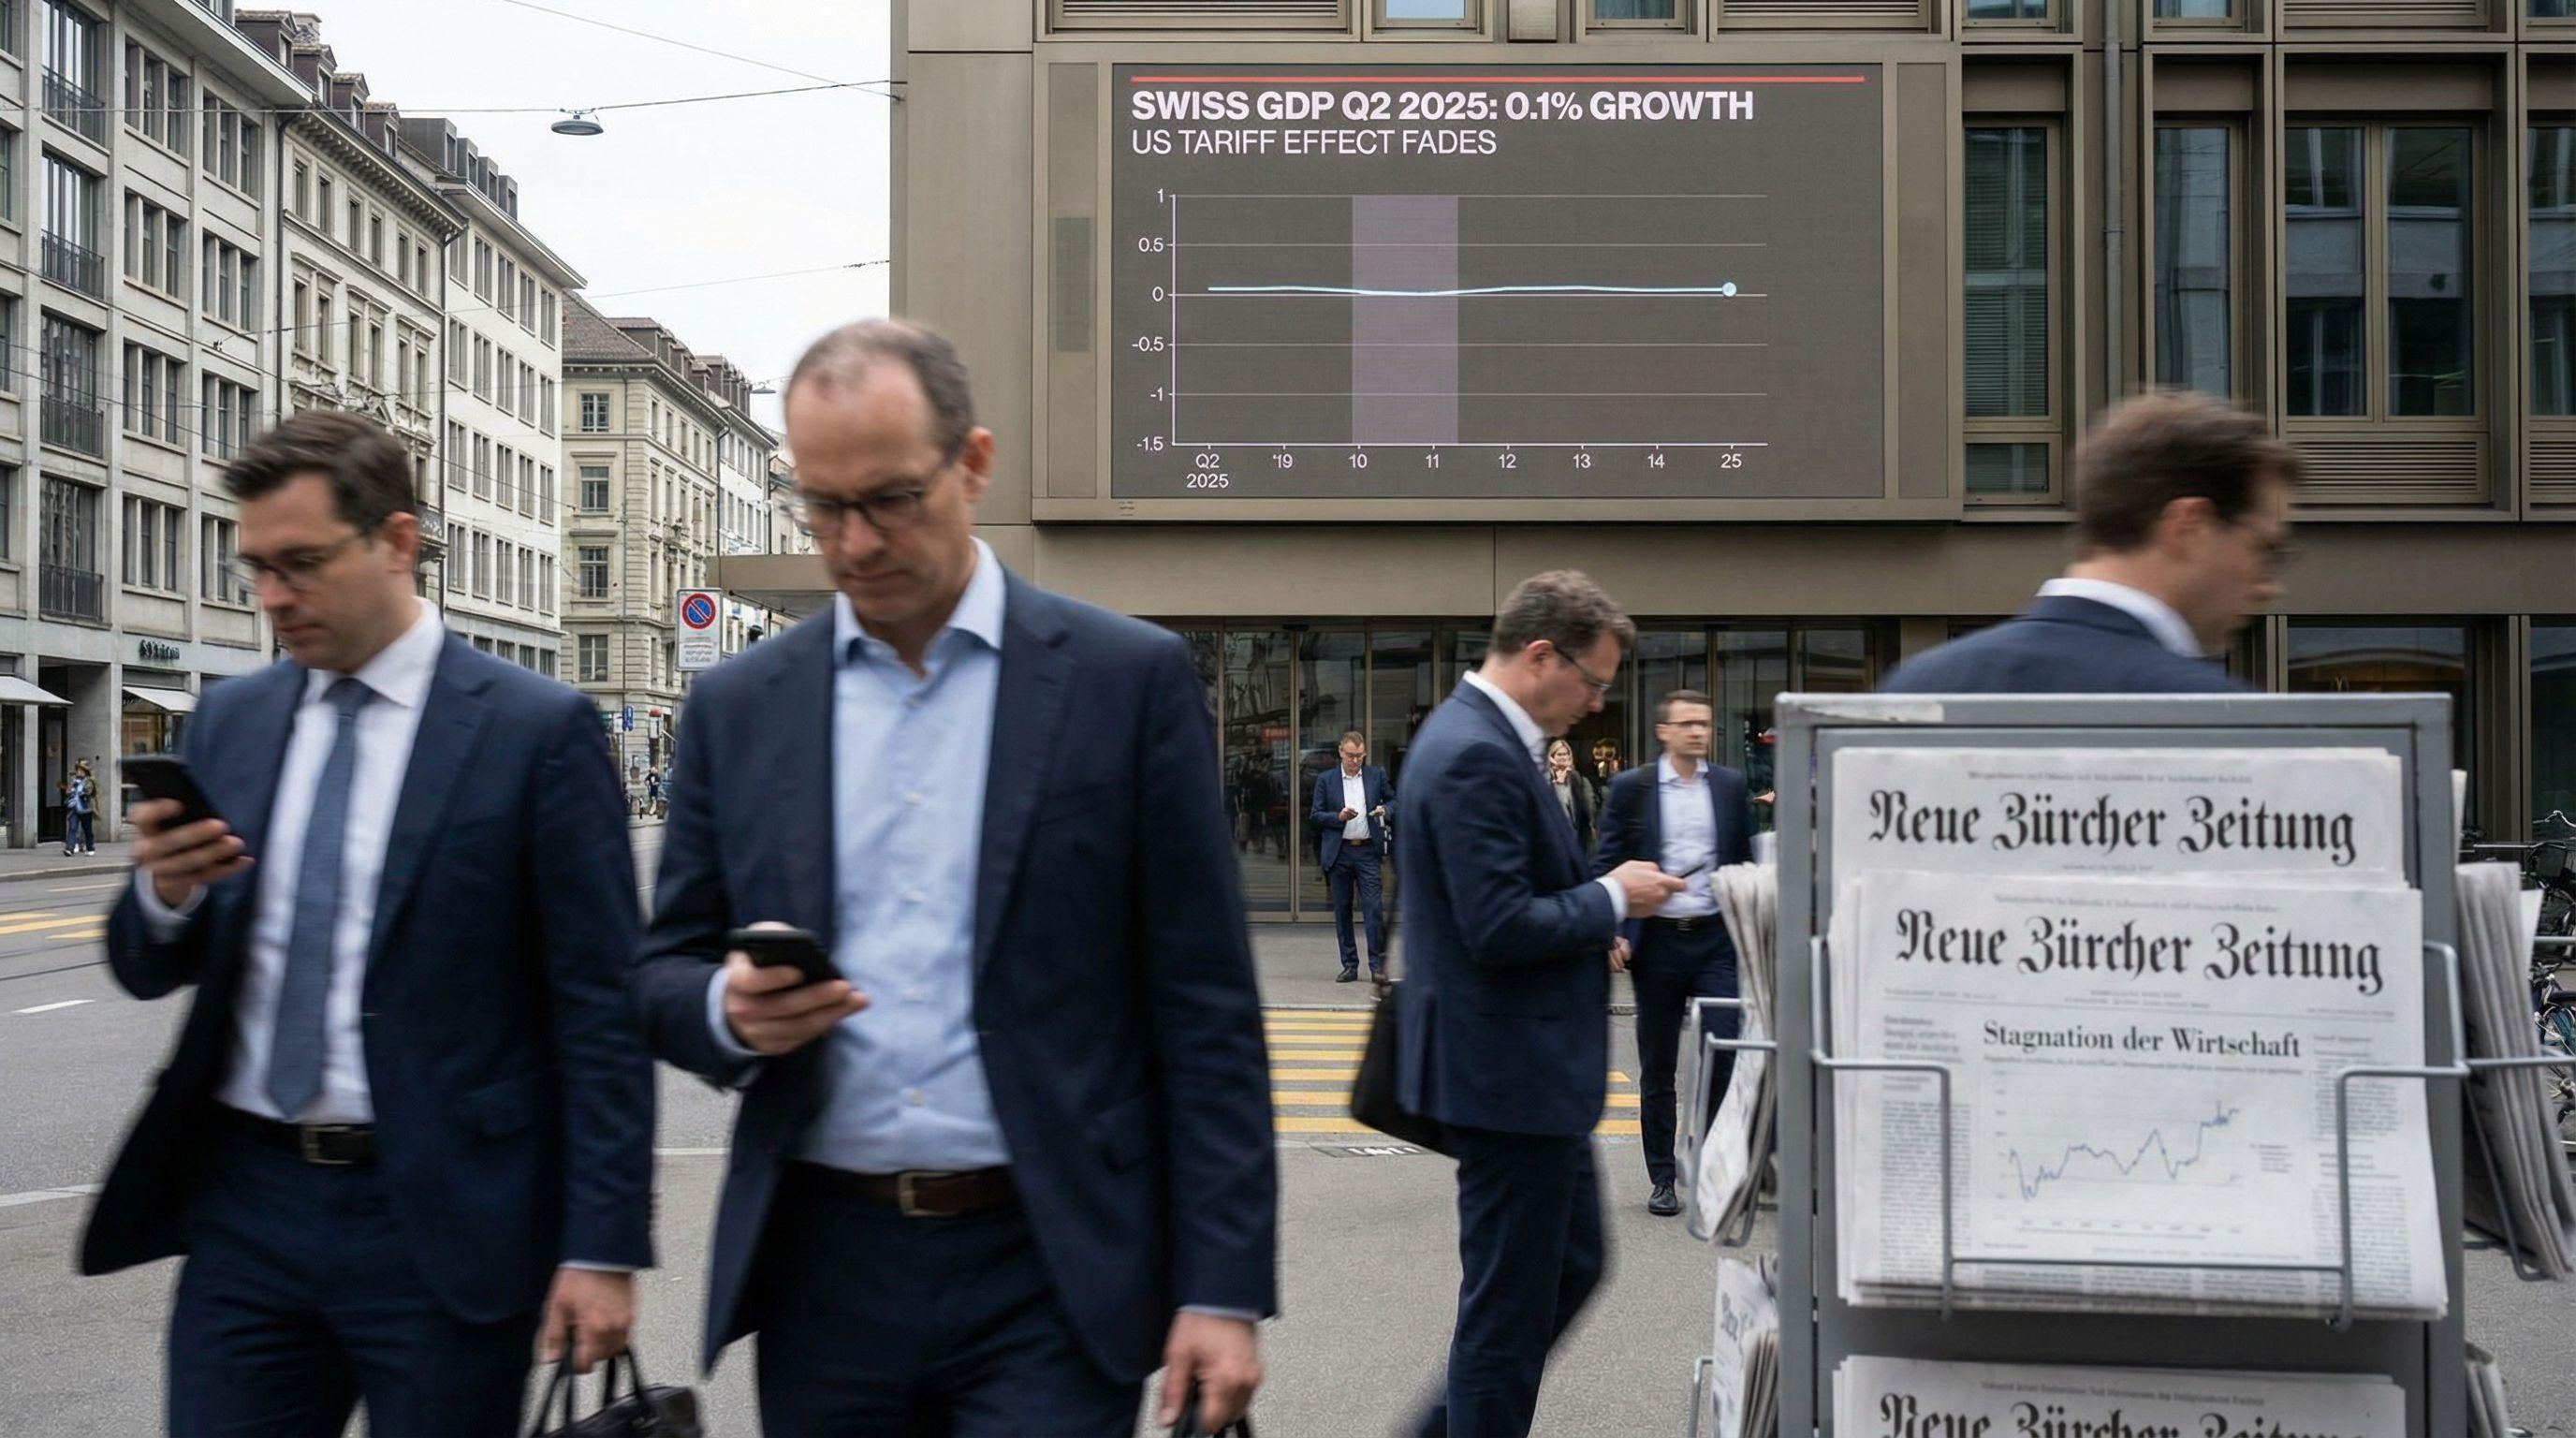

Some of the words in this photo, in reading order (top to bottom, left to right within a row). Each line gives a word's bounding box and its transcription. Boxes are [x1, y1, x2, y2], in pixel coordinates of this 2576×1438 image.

[1131, 90, 1251, 121] SWISS
[1256, 90, 1335, 121] GDP
[1341, 90, 1392, 122] Q2
[1398, 90, 1498, 121] 2025:
[1504, 90, 1584, 121] 0.1%
[1589, 90, 1754, 121] GROWTH
[1132, 129, 1172, 154] US
[1178, 129, 1278, 154] TARIFF
[1284, 129, 1396, 155] EFFECT
[1402, 129, 1497, 154] FADES
[1156, 187, 1164, 204] 1
[1137, 237, 1164, 253] 0.5
[1151, 286, 1164, 302] 0
[1131, 335, 1164, 352] -0.5
[1149, 386, 1164, 402] -1
[1136, 435, 1164, 451] -1.5
[1194, 453, 1220, 469] Q2
[1349, 453, 1368, 469] 10
[1425, 453, 1439, 469] 11
[1498, 453, 1516, 469] 12
[1573, 453, 1591, 469] 13
[1647, 453, 1665, 469] 14
[1720, 453, 1742, 469] 25
[1186, 473, 1230, 489] 2025
[1869, 789, 1981, 844] Neue
[1992, 792, 2167, 856] Zürcher
[2178, 795, 2357, 866] Zeitung
[1896, 908, 2008, 965] Neue
[2016, 915, 2192, 979] Zürcher
[2203, 922, 2384, 997] Zeitung
[1983, 1020, 2114, 1051] Stagnation
[2122, 1024, 2164, 1052] der
[2170, 1027, 2301, 1058] Wirtschaft
